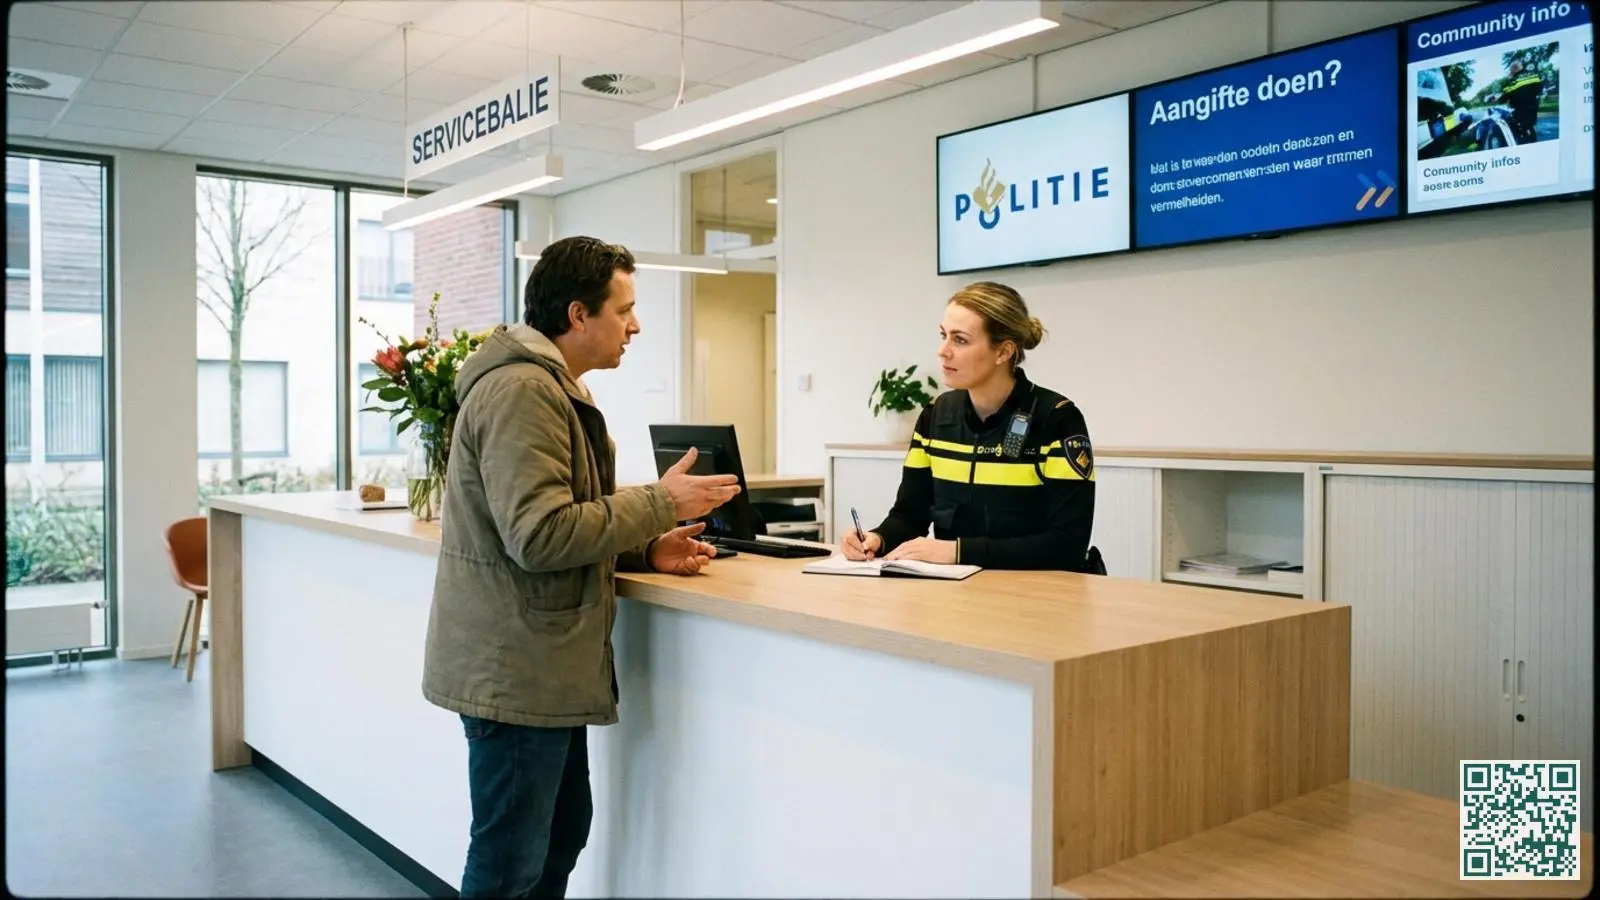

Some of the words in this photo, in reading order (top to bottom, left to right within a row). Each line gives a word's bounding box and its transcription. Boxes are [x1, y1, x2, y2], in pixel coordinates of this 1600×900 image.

[1417, 12, 1525, 48] Community
[1531, 2, 1571, 23] info
[1150, 85, 1250, 125] Aangifte
[1257, 59, 1342, 101] doen?
[412, 76, 549, 165] SERVICEBALIE
[1338, 129, 1354, 142] en
[1293, 156, 1324, 170] waar
[1491, 156, 1521, 169] infos
[955, 166, 1109, 230] POLITIE
